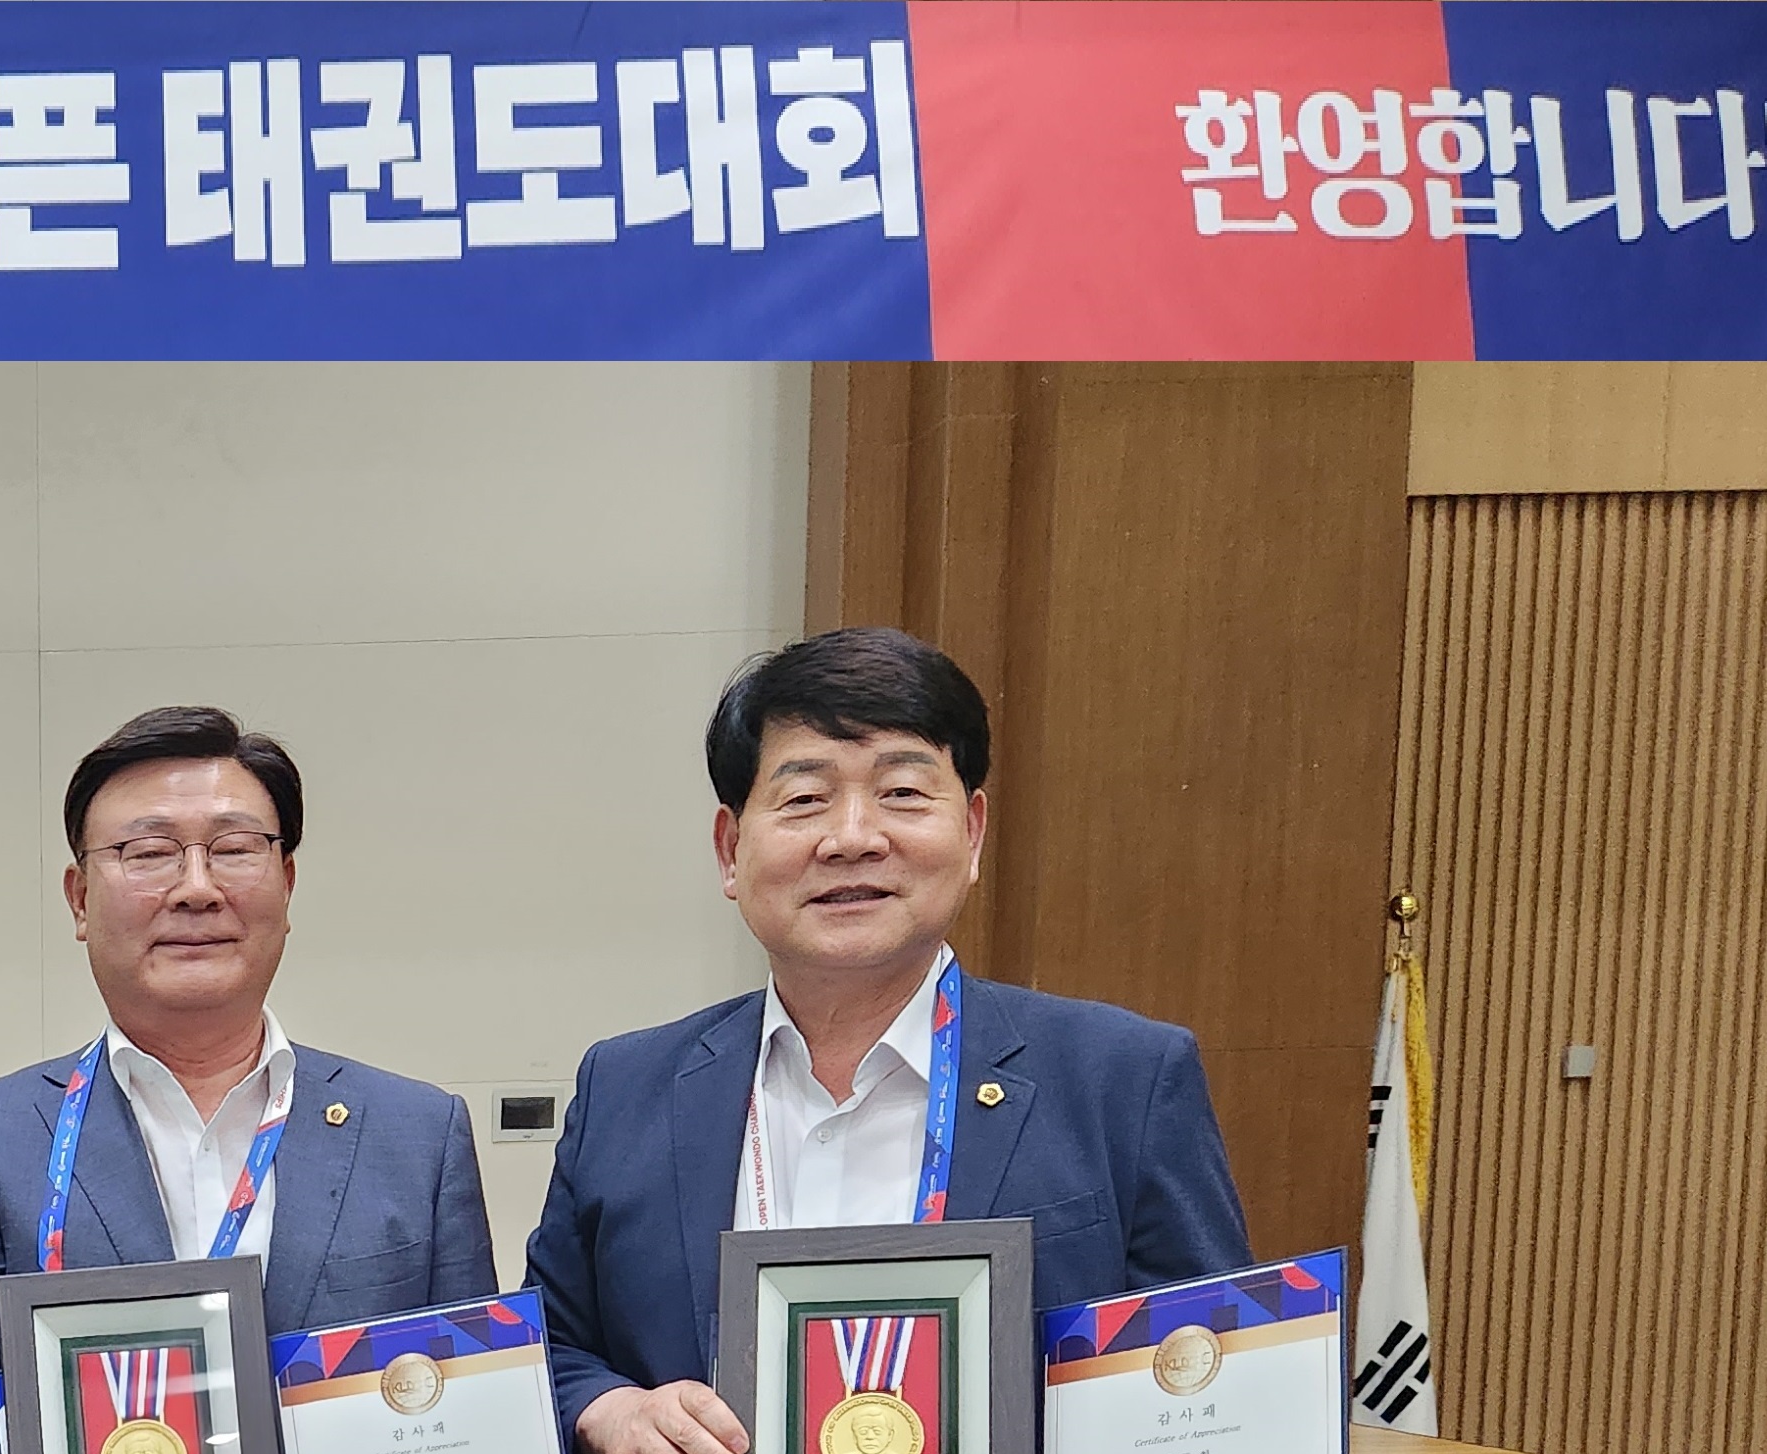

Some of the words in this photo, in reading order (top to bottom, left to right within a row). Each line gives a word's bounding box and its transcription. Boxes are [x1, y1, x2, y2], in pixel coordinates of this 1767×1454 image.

[162, 39, 920, 268] 태권도대회
[1174, 89, 1766, 243] 환영합니다
[751, 1136, 765, 1197] TAEKWONDO
[757, 1197, 769, 1226] OPEN
